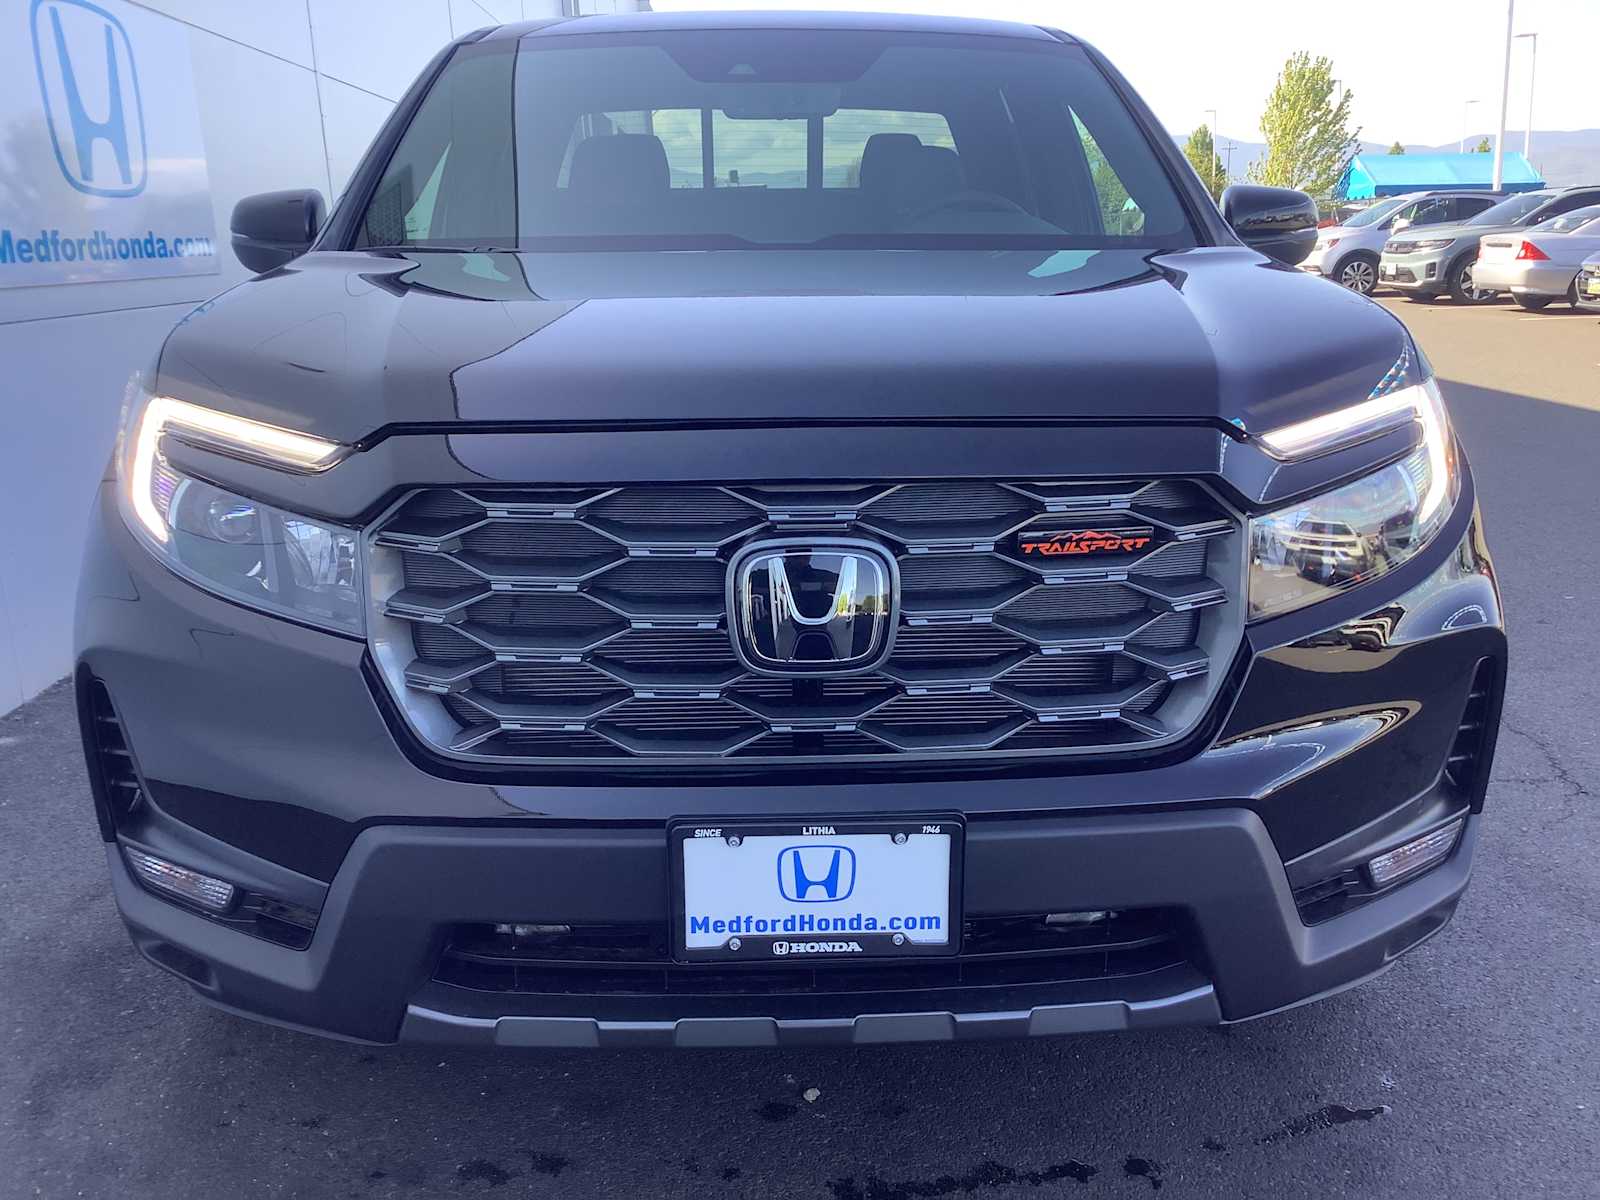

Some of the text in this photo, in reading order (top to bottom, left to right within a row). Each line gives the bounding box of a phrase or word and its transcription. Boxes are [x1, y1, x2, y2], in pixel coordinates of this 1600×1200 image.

[1021, 537, 1150, 555] TRAILSPORT
[694, 828, 722, 837] SINCE
[802, 826, 836, 836] LITHIA
[690, 914, 941, 933] MedfordHonda.com
[790, 942, 862, 952] HONDA
